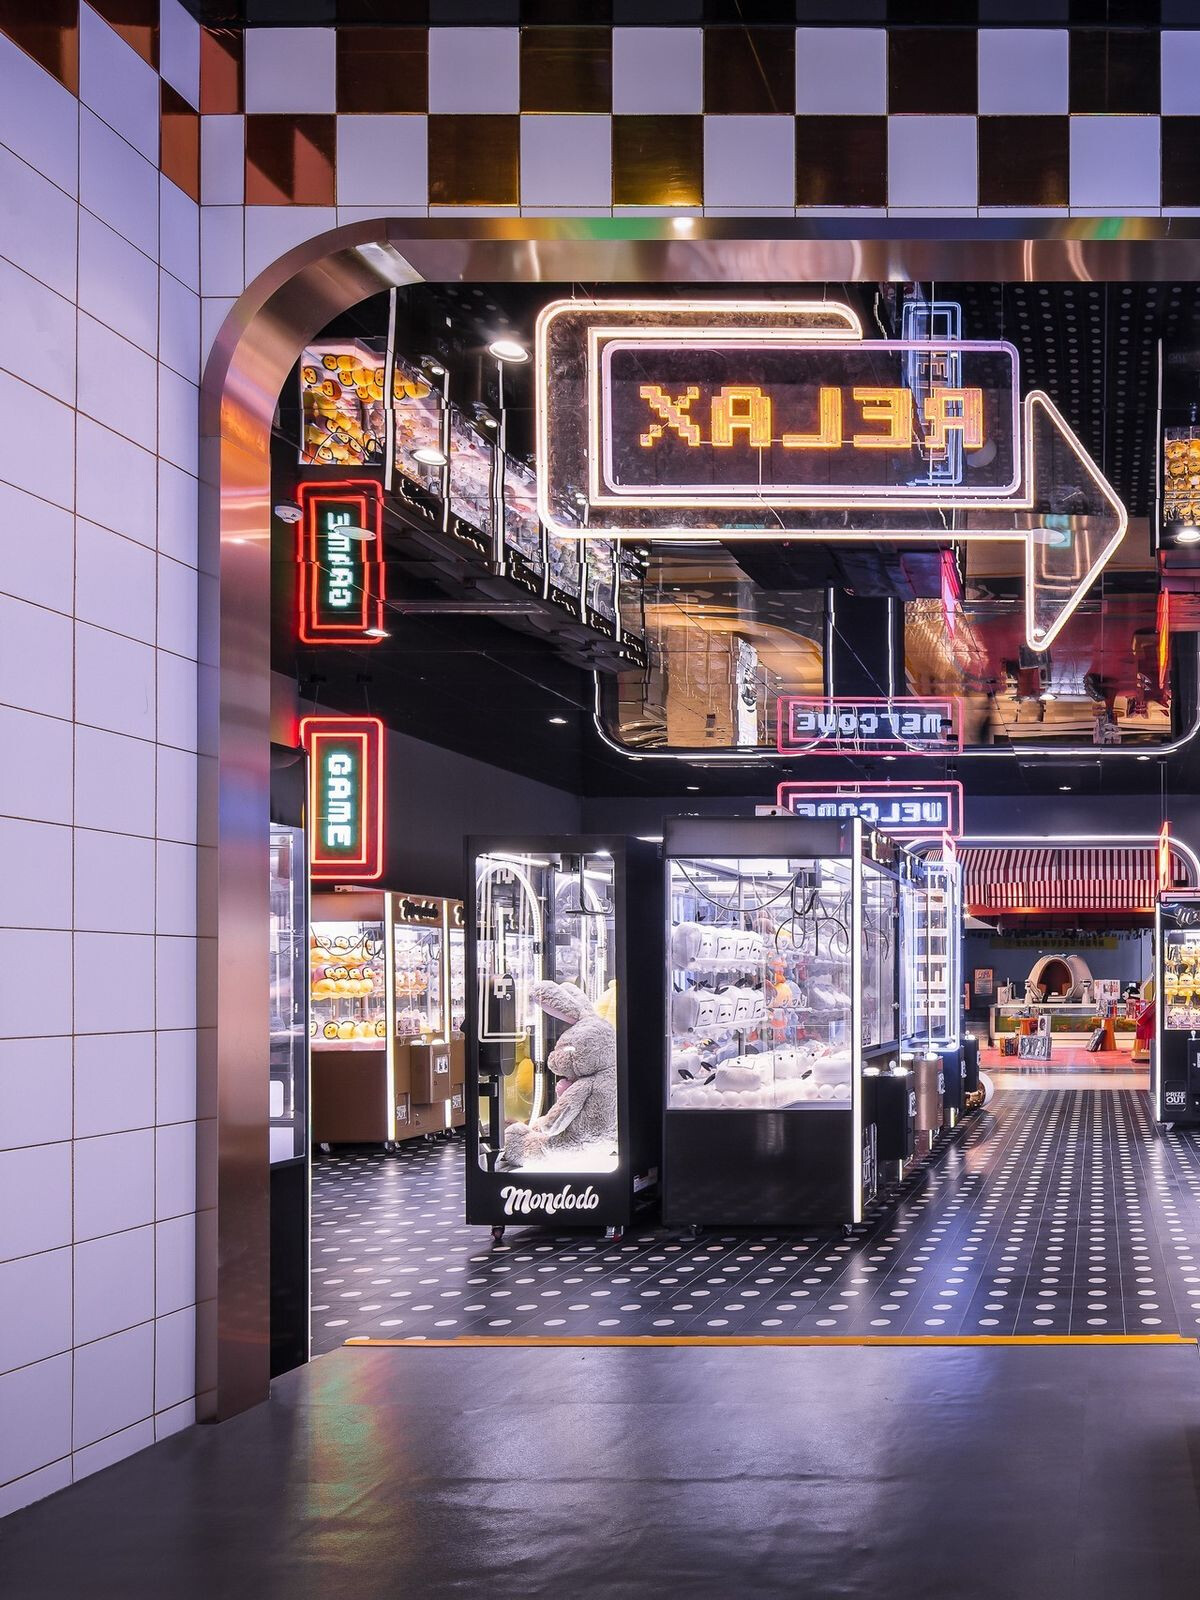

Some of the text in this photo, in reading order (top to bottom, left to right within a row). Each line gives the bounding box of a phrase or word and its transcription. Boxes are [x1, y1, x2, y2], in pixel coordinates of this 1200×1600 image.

[797, 713, 943, 734] WELCOME
[327, 754, 352, 846] GAME
[501, 1185, 599, 1215] Mondodo
